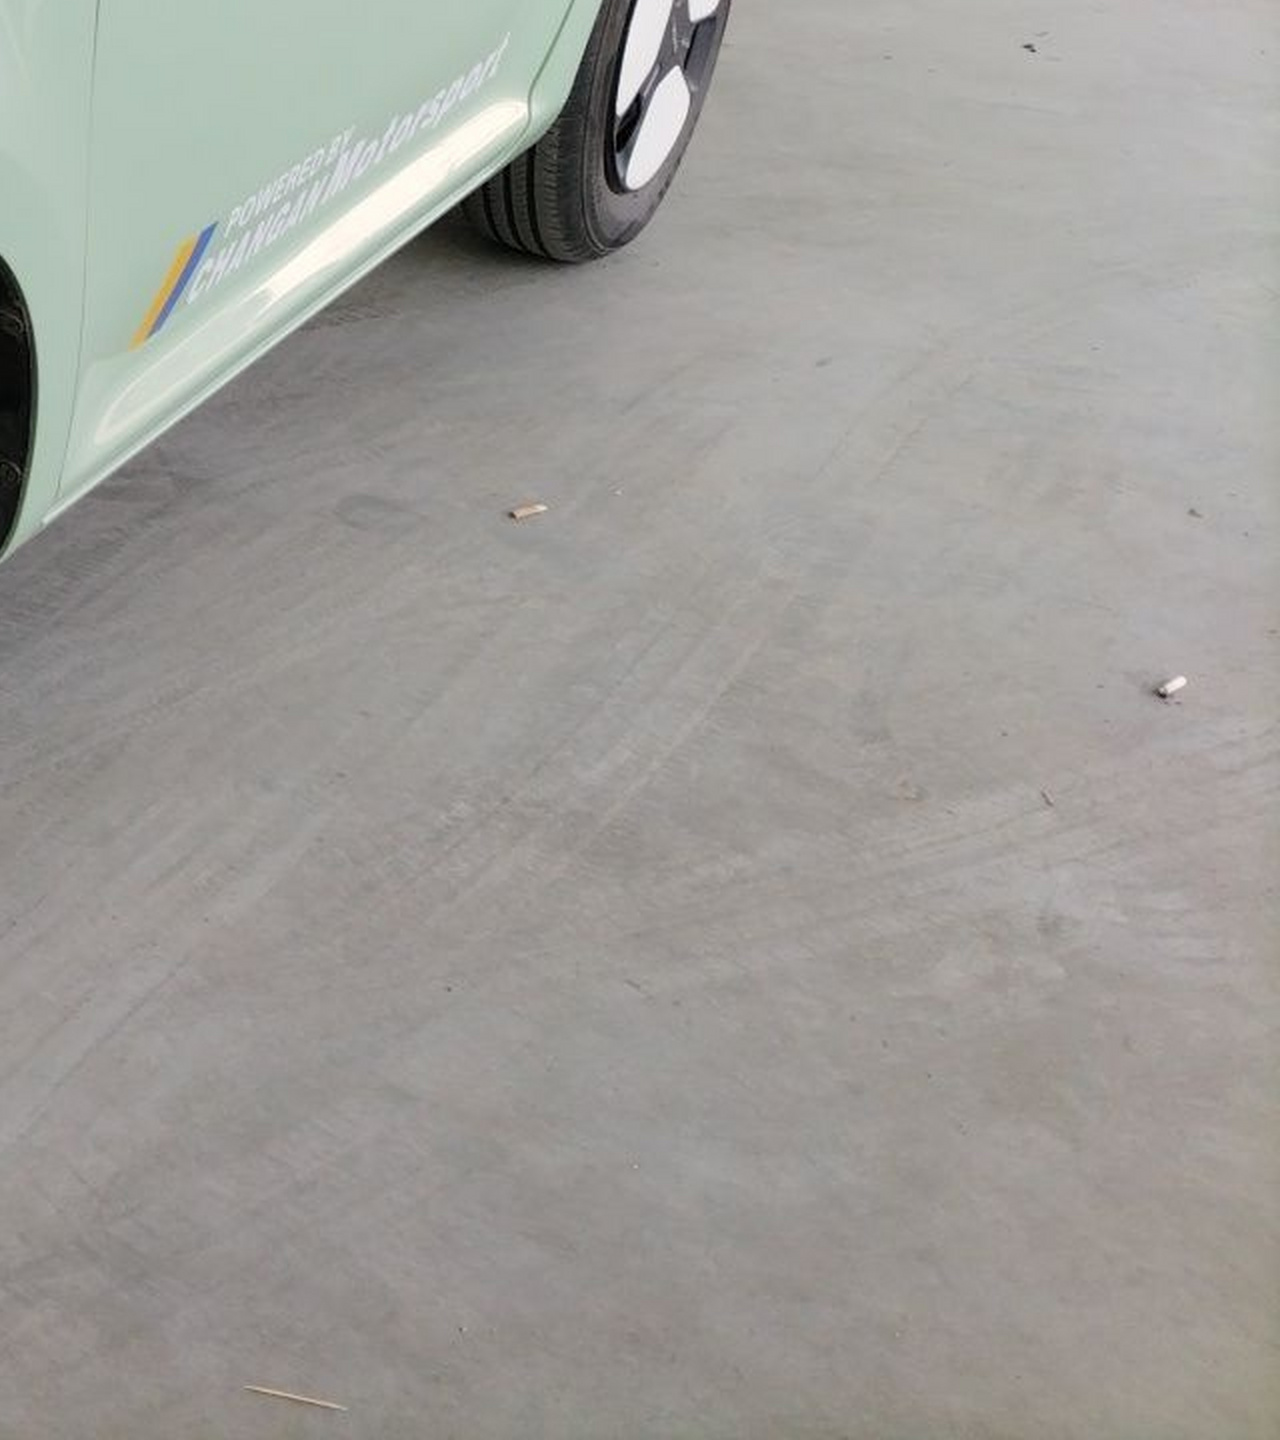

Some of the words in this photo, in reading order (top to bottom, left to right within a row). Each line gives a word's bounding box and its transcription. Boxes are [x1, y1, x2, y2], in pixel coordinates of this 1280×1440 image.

[186, 171, 331, 306] CHANGAN
[320, 30, 511, 205] Motorsport
[223, 147, 325, 239] POWERED
